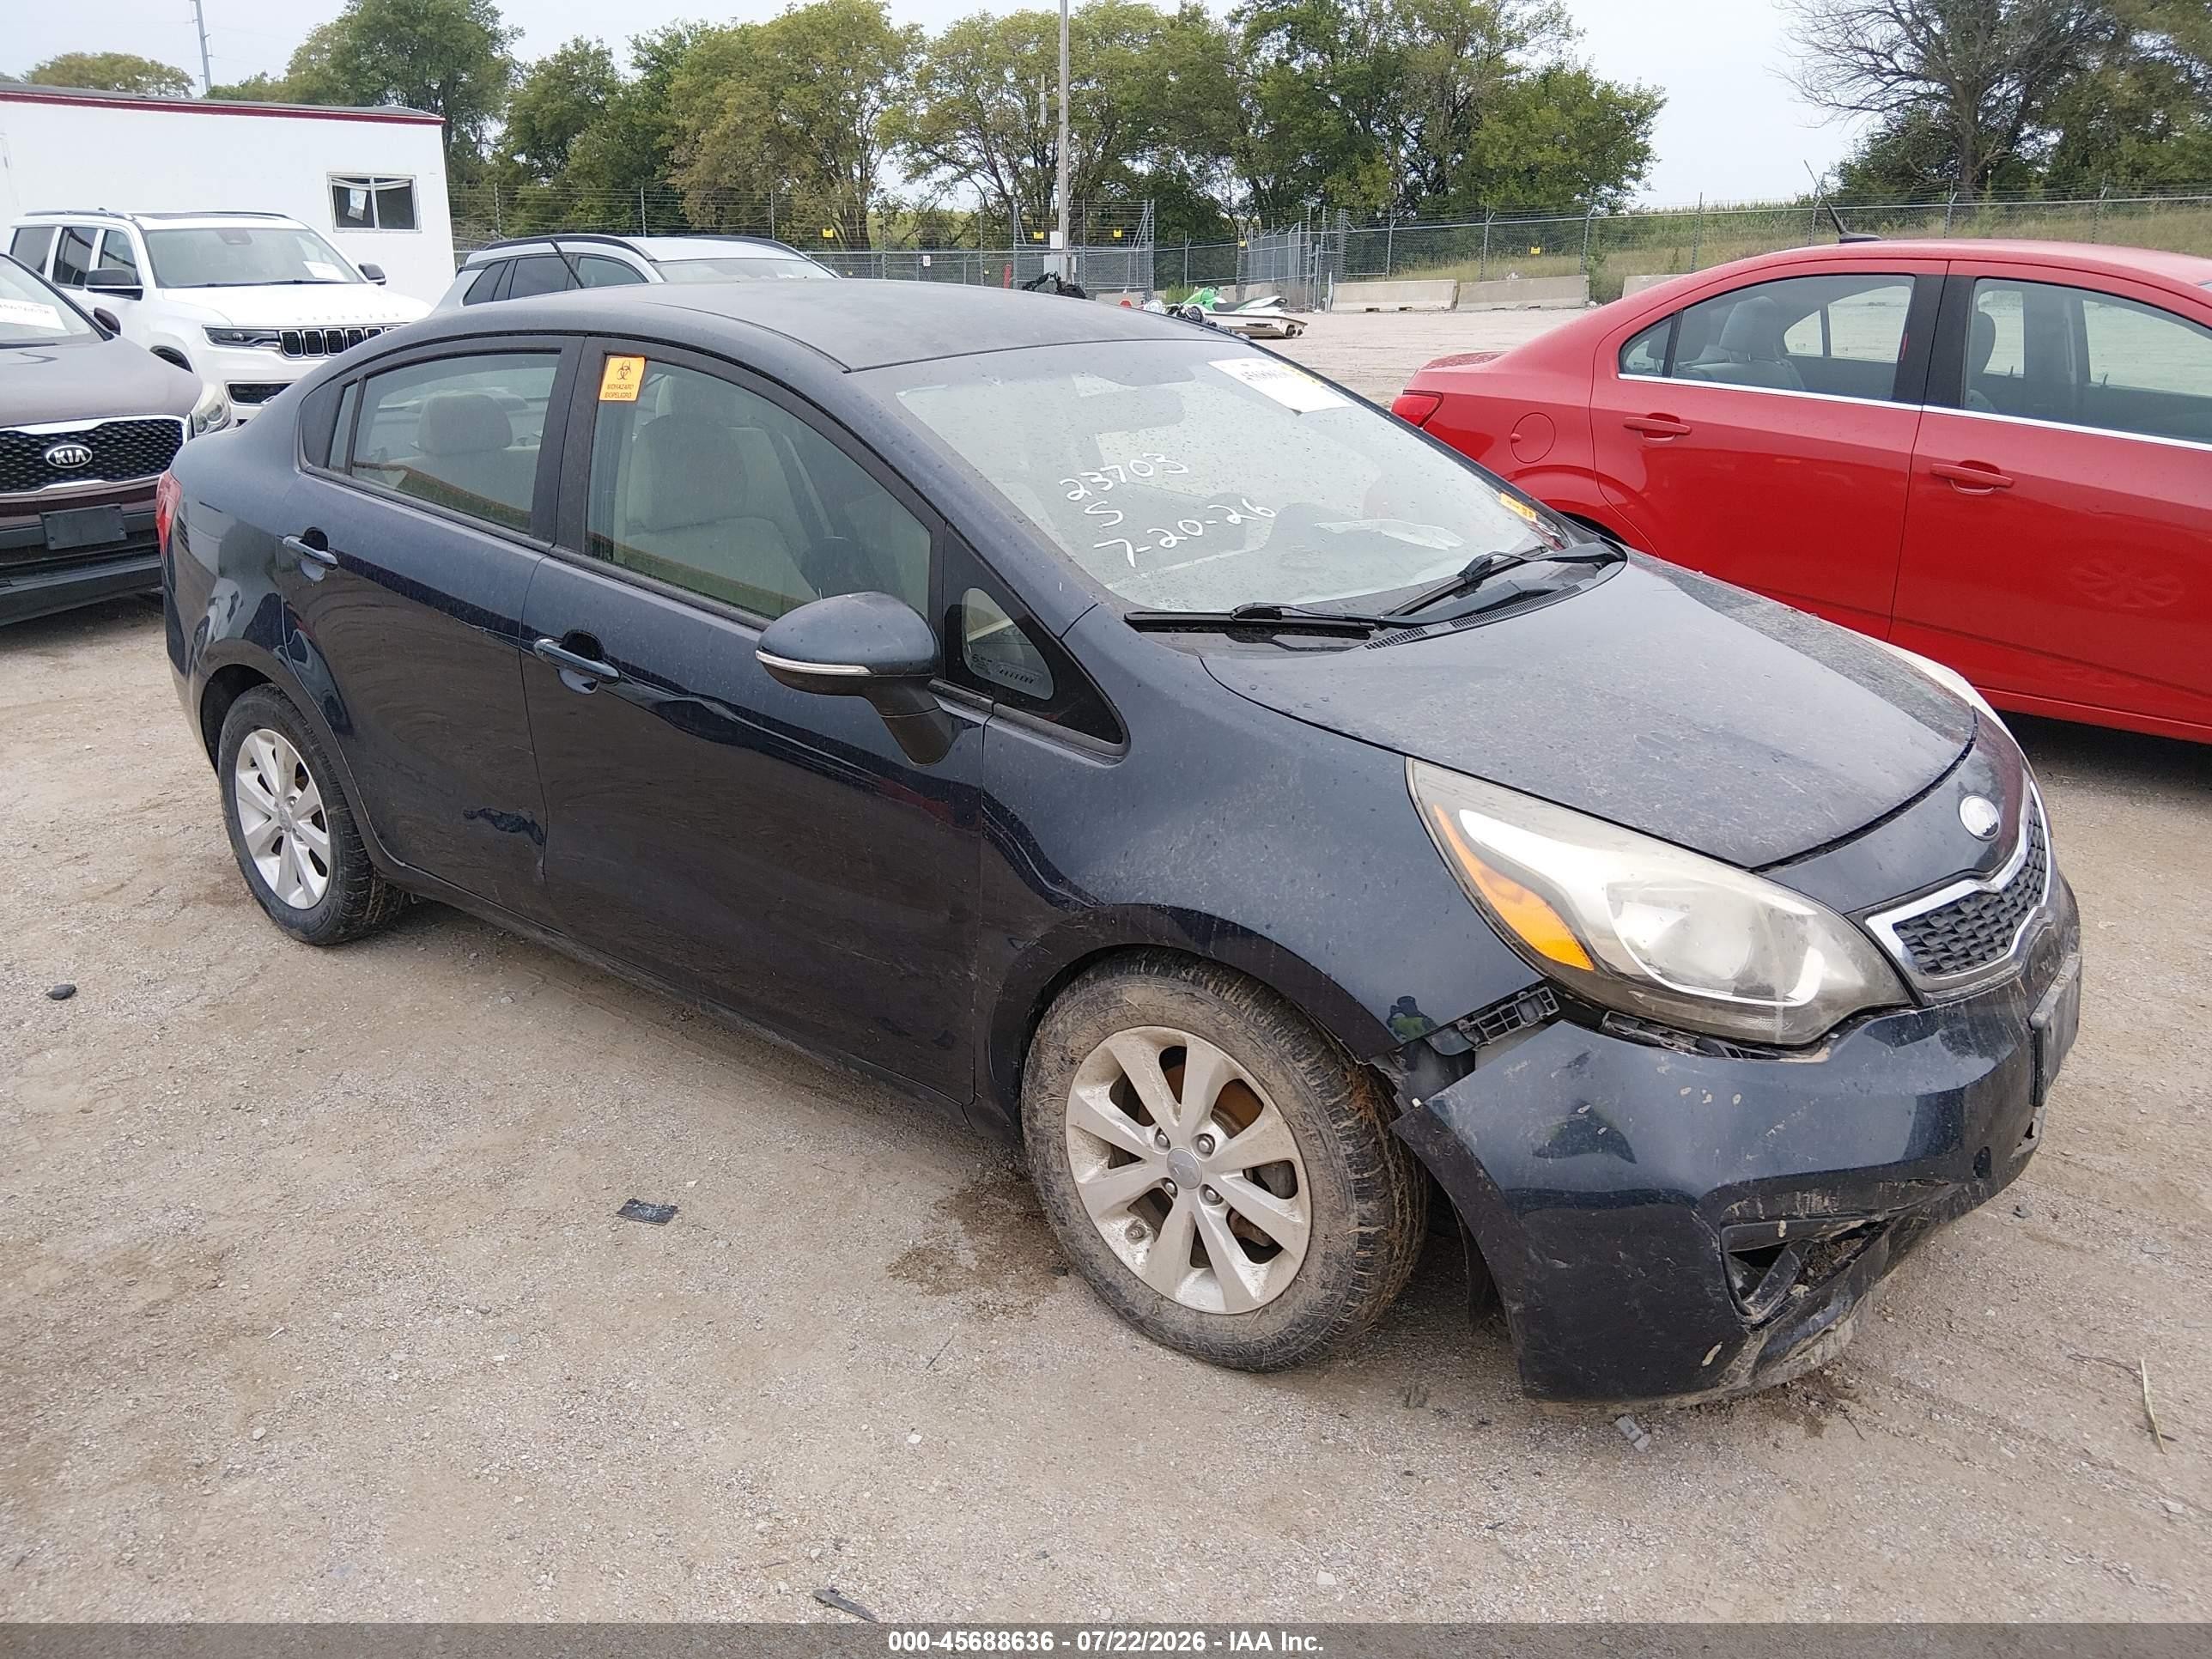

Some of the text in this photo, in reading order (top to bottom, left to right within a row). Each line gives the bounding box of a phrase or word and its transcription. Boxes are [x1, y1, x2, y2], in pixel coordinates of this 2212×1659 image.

[53, 449, 87, 465] KIA
[1059, 453, 1189, 501] 23703
[1093, 497, 1277, 568] 7-20-26
